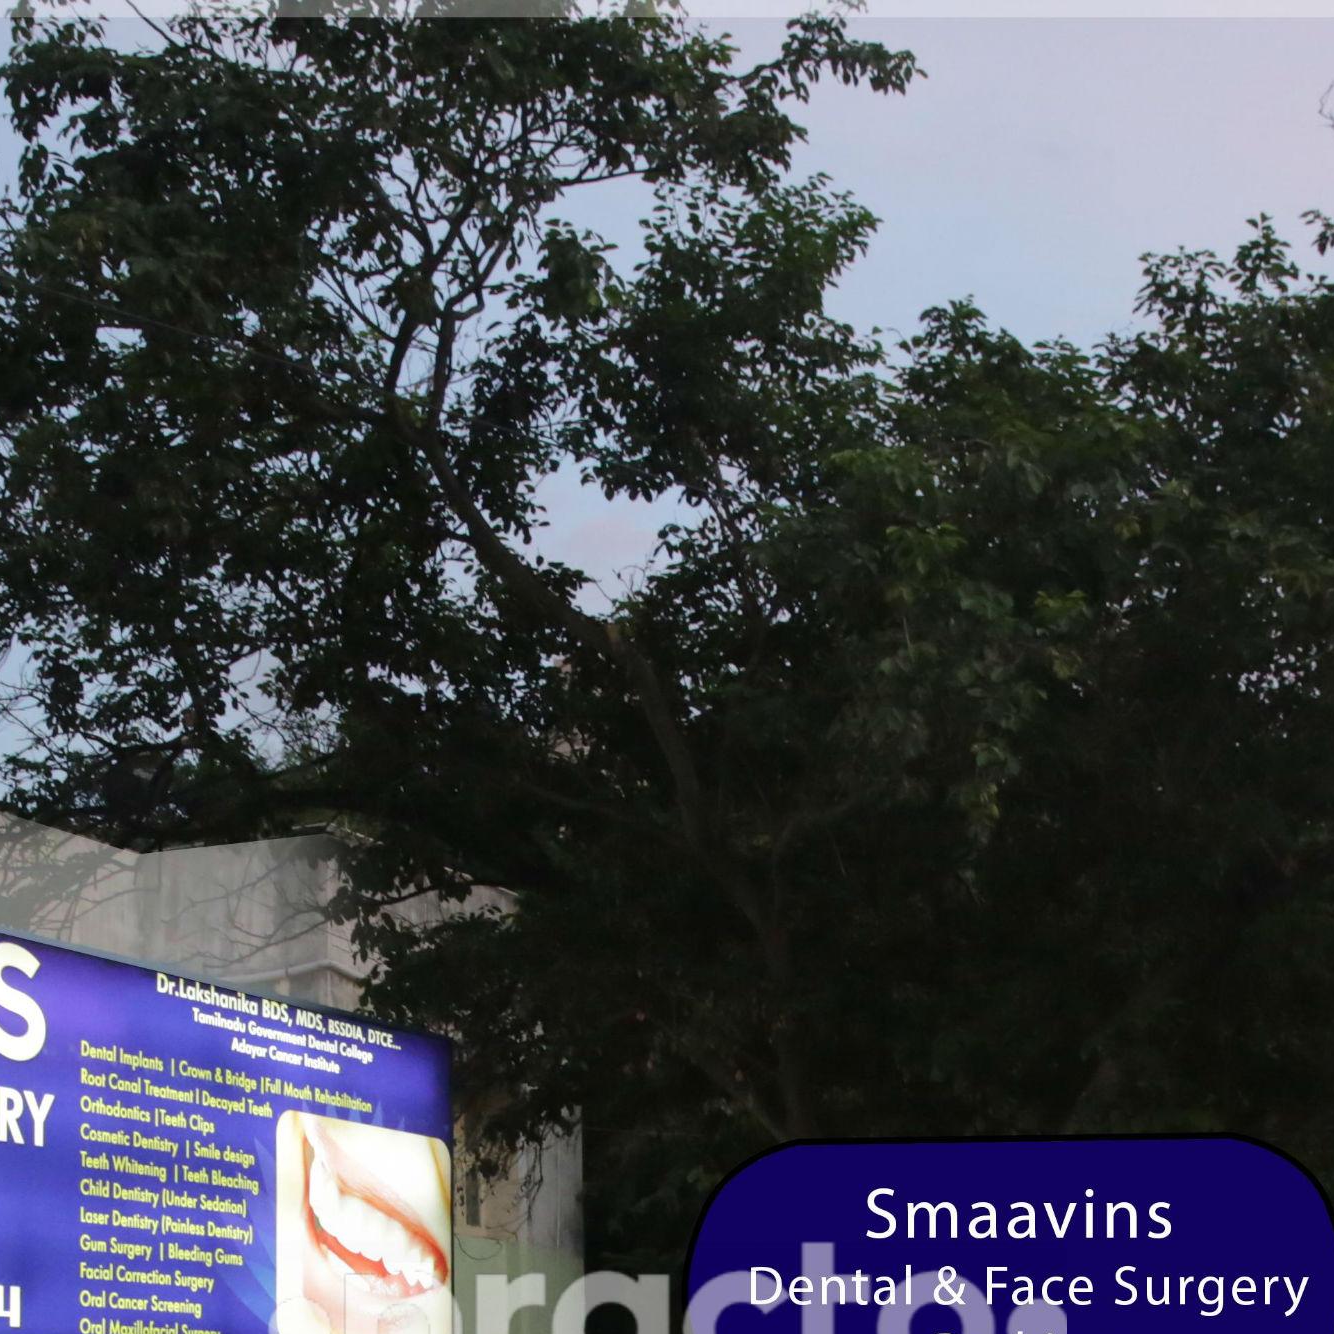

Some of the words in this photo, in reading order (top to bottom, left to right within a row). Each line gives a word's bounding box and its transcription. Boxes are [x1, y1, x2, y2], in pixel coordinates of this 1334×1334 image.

[192, 1006, 246, 1034] Tamilnadu
[248, 1021, 307, 1048] Government
[308, 1034, 338, 1056] Dental
[340, 1042, 373, 1064] College
[262, 998, 292, 1028] BDS,
[296, 1008, 326, 1035] MDS,
[81, 1040, 116, 1062] Dental
[119, 1047, 164, 1073] Implants
[179, 1061, 212, 1083] Crown
[225, 1068, 257, 1092] Bridge
[283, 1080, 312, 1102] Mouth
[315, 1087, 372, 1114] Rehabilitation
[269, 1045, 303, 1067] Cancer
[304, 1051, 340, 1075] Institute
[81, 1069, 106, 1089] Root
[108, 1073, 142, 1095] Canal
[144, 1079, 194, 1102] Treatment
[202, 1090, 245, 1117] Decayed
[247, 1098, 273, 1119] Teeth
[81, 1096, 151, 1123] Orthodontics
[189, 1112, 215, 1134] Clips
[80, 1124, 130, 1146] Cosmetic
[133, 1130, 179, 1157] Dentistry
[194, 1141, 221, 1162] Smile
[223, 1147, 255, 1169] design
[80, 1151, 109, 1170] Teeth
[112, 1155, 166, 1182] Whitening
[182, 1165, 209, 1184] Teeth
[212, 1170, 259, 1195] Bleaching
[80, 1178, 110, 1198] Child
[113, 1181, 159, 1208] Dentistry
[162, 1188, 197, 1210] (Under
[200, 1194, 247, 1218] Sedation)
[80, 1206, 109, 1225] Laser
[112, 1210, 159, 1235] Dentistry
[162, 1216, 205, 1238] (Painless
[207, 1221, 254, 1244] Dentistry)
[80, 1234, 107, 1252] Gum
[110, 1238, 152, 1261] Surgery
[168, 1243, 213, 1267] Bleeding
[215, 1248, 243, 1266] Gums
[80, 1262, 113, 1281] Facial
[116, 1266, 171, 1286] Correction
[174, 1271, 214, 1293] Surgery
[80, 1290, 106, 1309] Oral
[109, 1292, 148, 1312] Cancer
[151, 1296, 202, 1319] Screening
